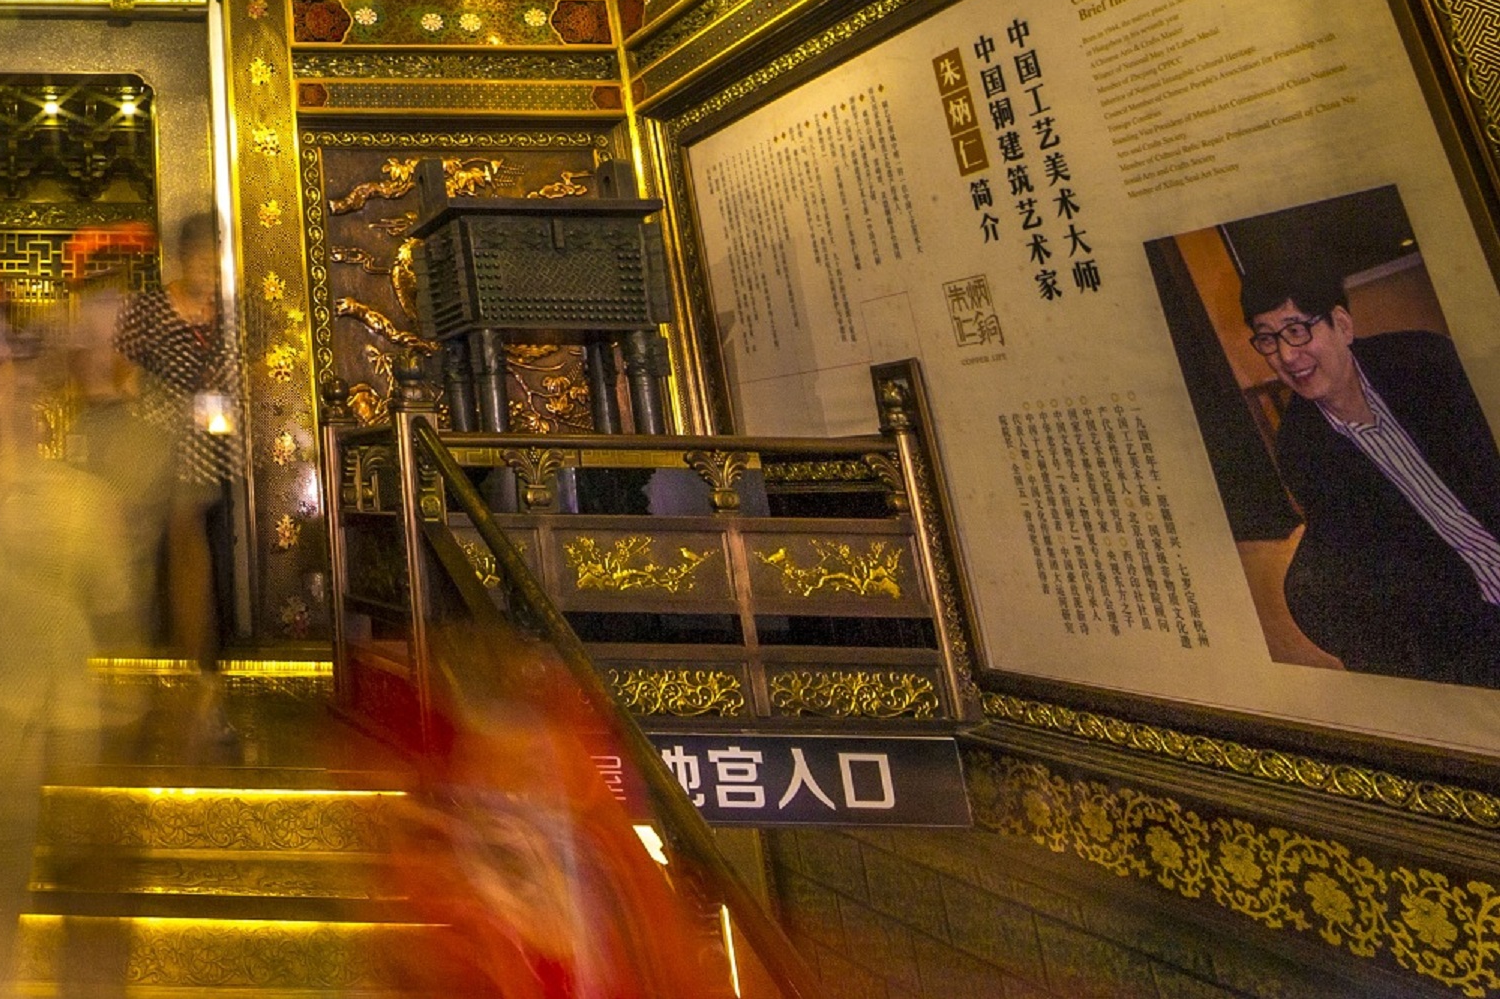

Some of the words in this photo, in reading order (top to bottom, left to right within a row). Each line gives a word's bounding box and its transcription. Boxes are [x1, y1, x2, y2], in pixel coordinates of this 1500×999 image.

[1078, 0, 1108, 21] Brief
[973, 34, 1063, 301] 中国铜建筑艺术家
[1007, 18, 1101, 294] 中国工艺美术大师
[1112, 403, 1152, 507] 中国工艺美术大师
